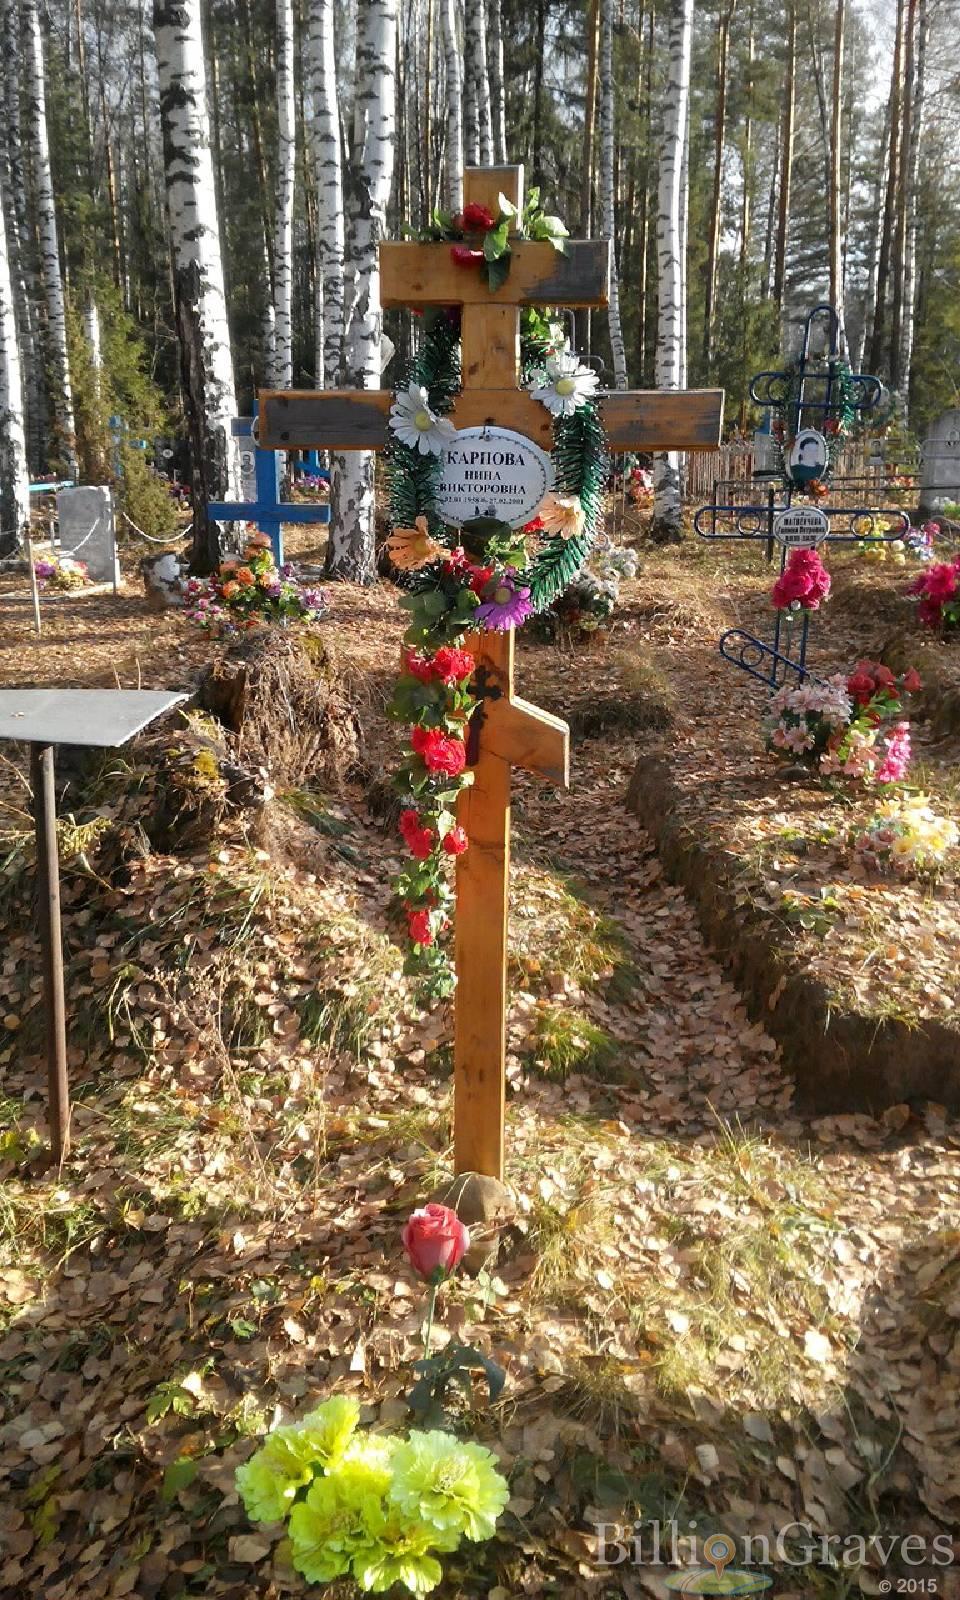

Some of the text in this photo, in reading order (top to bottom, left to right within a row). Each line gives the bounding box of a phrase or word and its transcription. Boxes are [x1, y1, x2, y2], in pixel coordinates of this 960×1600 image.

[447, 451, 525, 466] КАРПОВА
[464, 470, 502, 481] НИНА
[439, 483, 527, 495] ВИКТОРОВНА
